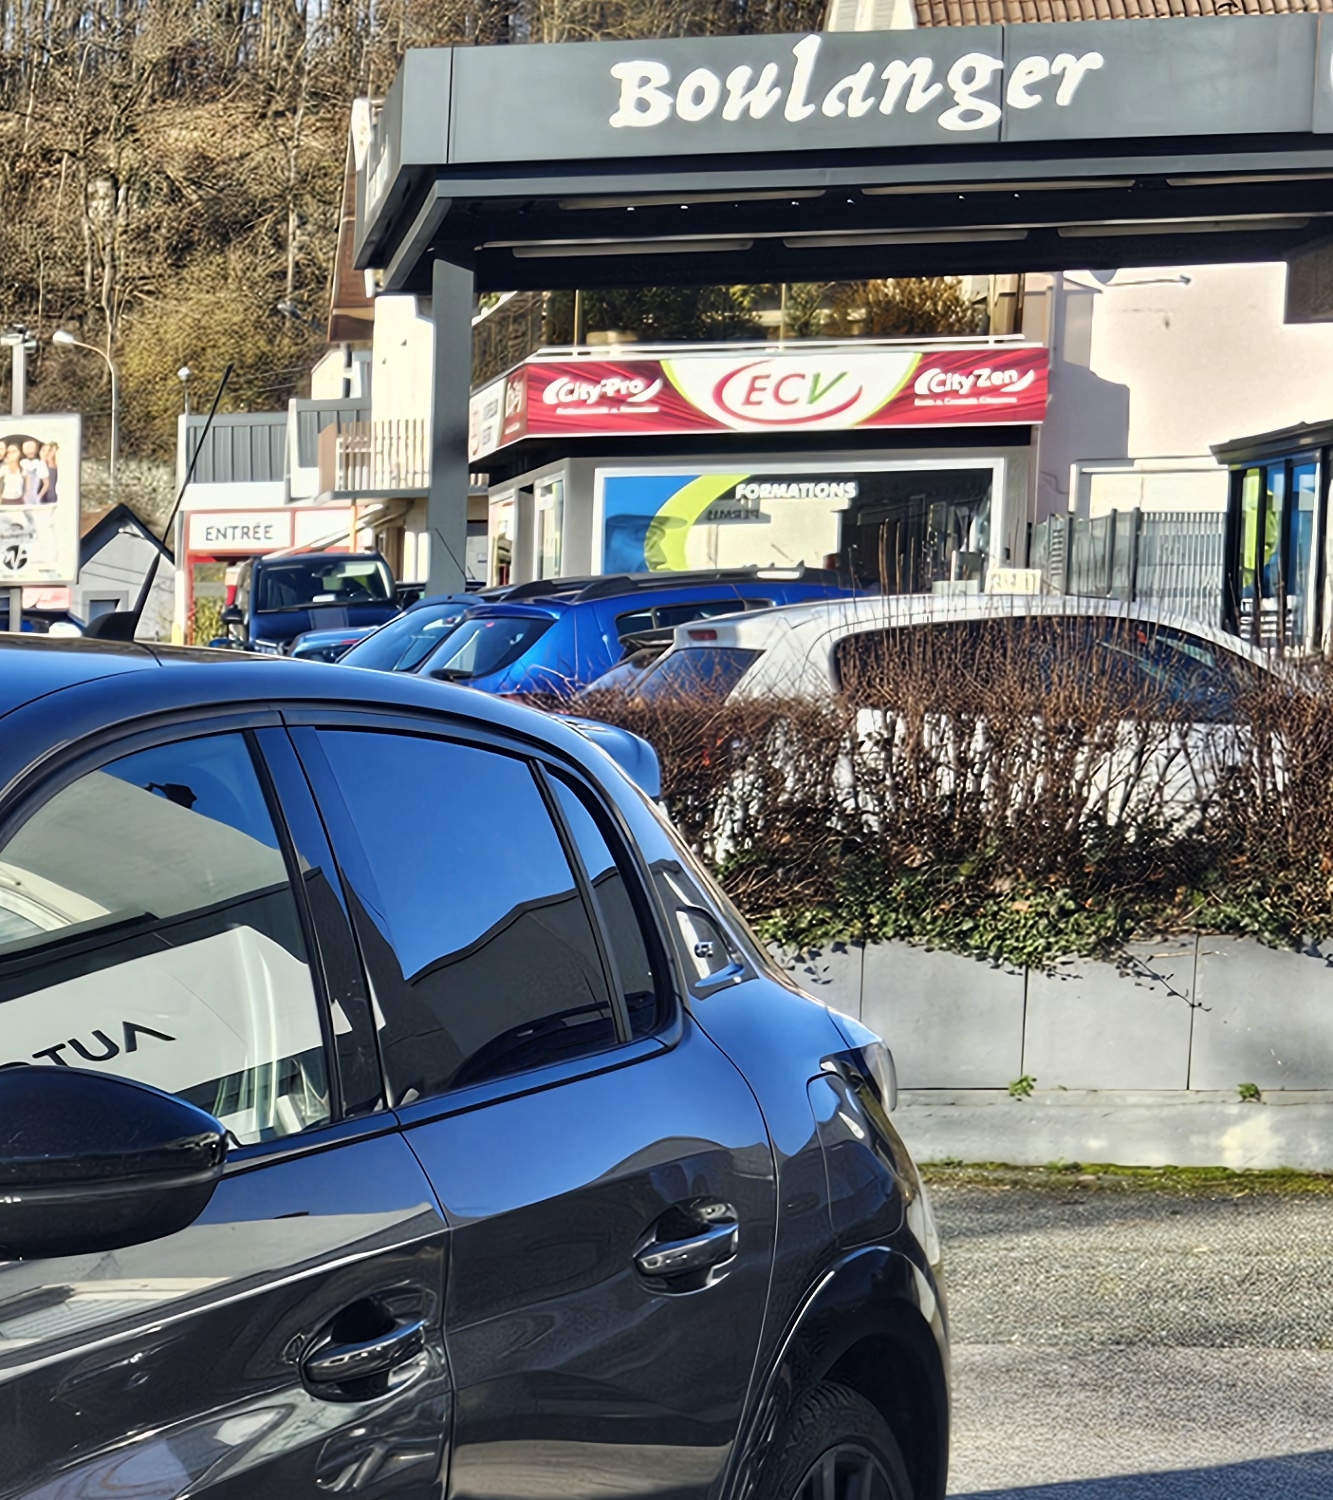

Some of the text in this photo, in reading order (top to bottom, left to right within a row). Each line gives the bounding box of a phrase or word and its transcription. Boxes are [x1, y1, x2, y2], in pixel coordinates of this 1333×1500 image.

[608, 33, 1104, 132] Boulanger
[740, 371, 849, 406] ECV
[735, 481, 858, 499] FORMATIONS
[205, 522, 274, 542] ENTRÉE
